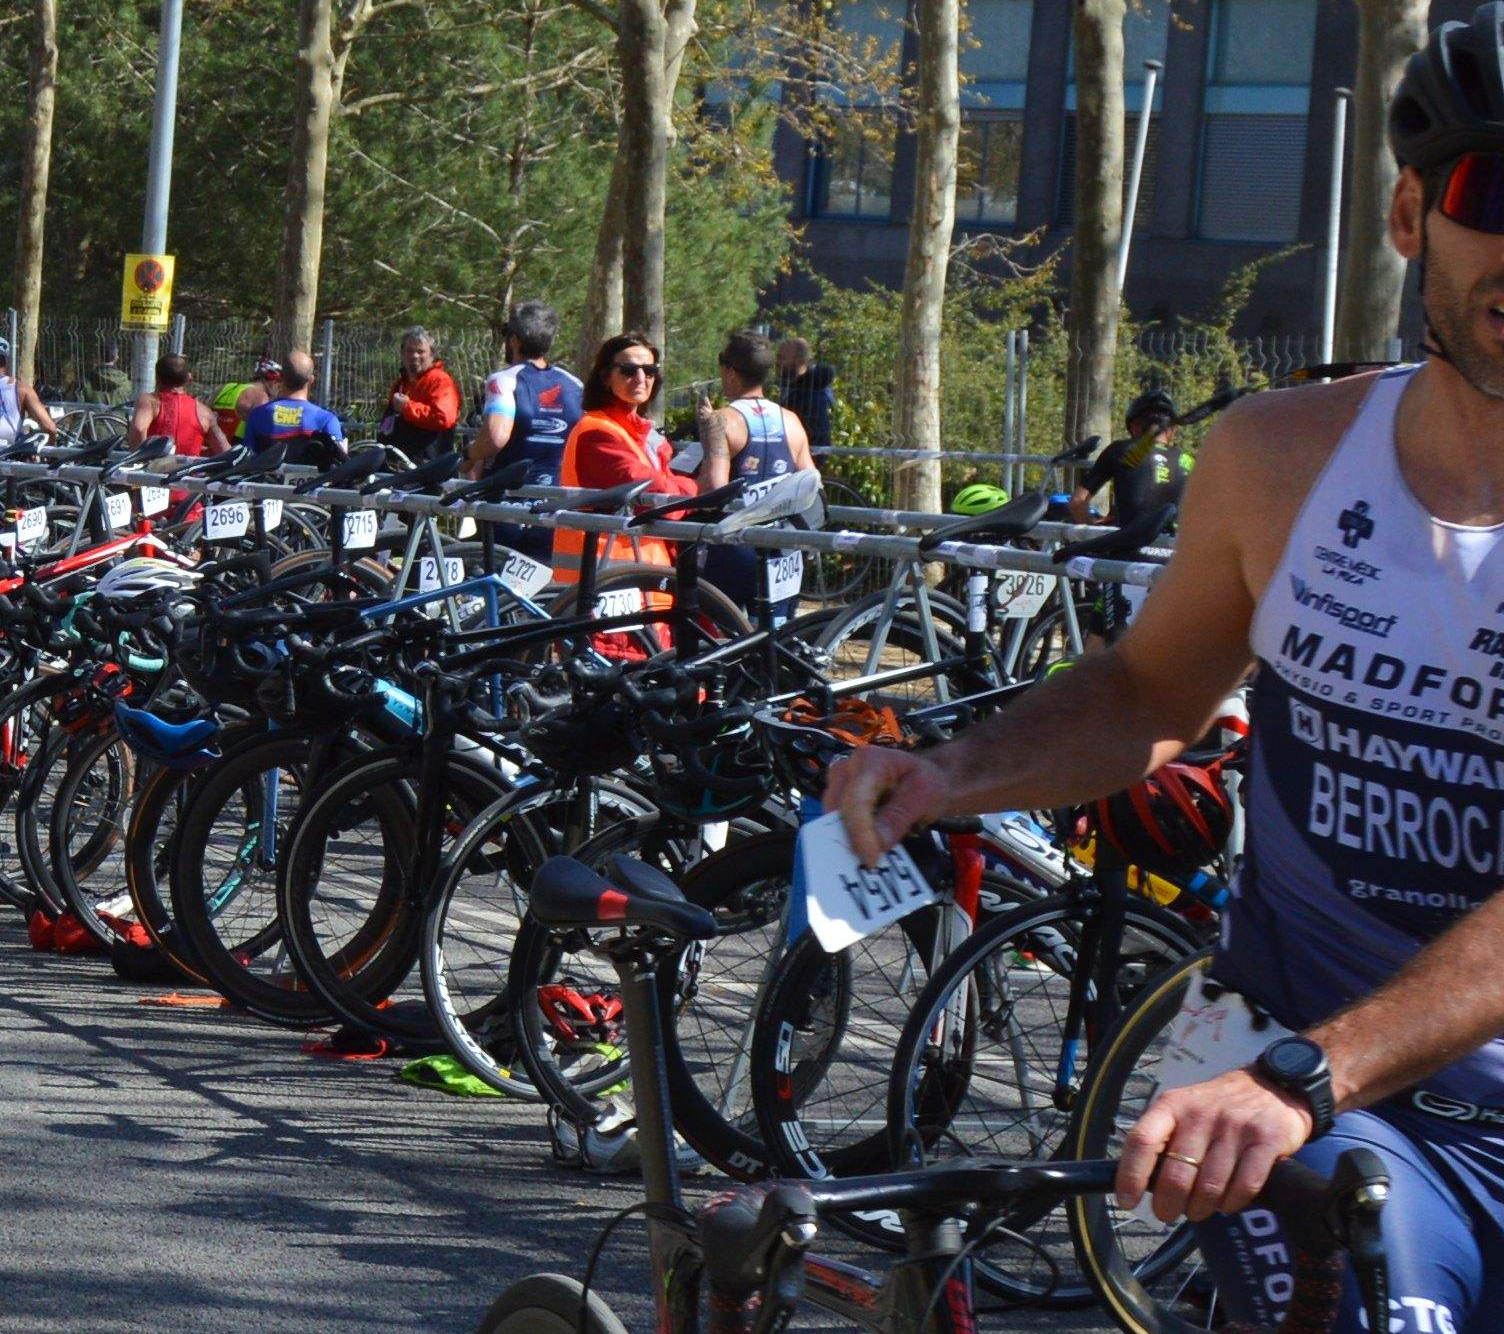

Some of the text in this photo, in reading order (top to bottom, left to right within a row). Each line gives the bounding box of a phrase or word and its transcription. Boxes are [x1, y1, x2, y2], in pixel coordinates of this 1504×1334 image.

[108, 497, 128, 517] 691
[210, 506, 244, 528] 2696
[347, 514, 374, 536] 2715
[425, 560, 460, 582] 218
[1343, 691, 1359, 705] &
[1369, 696, 1451, 726] SPORT
